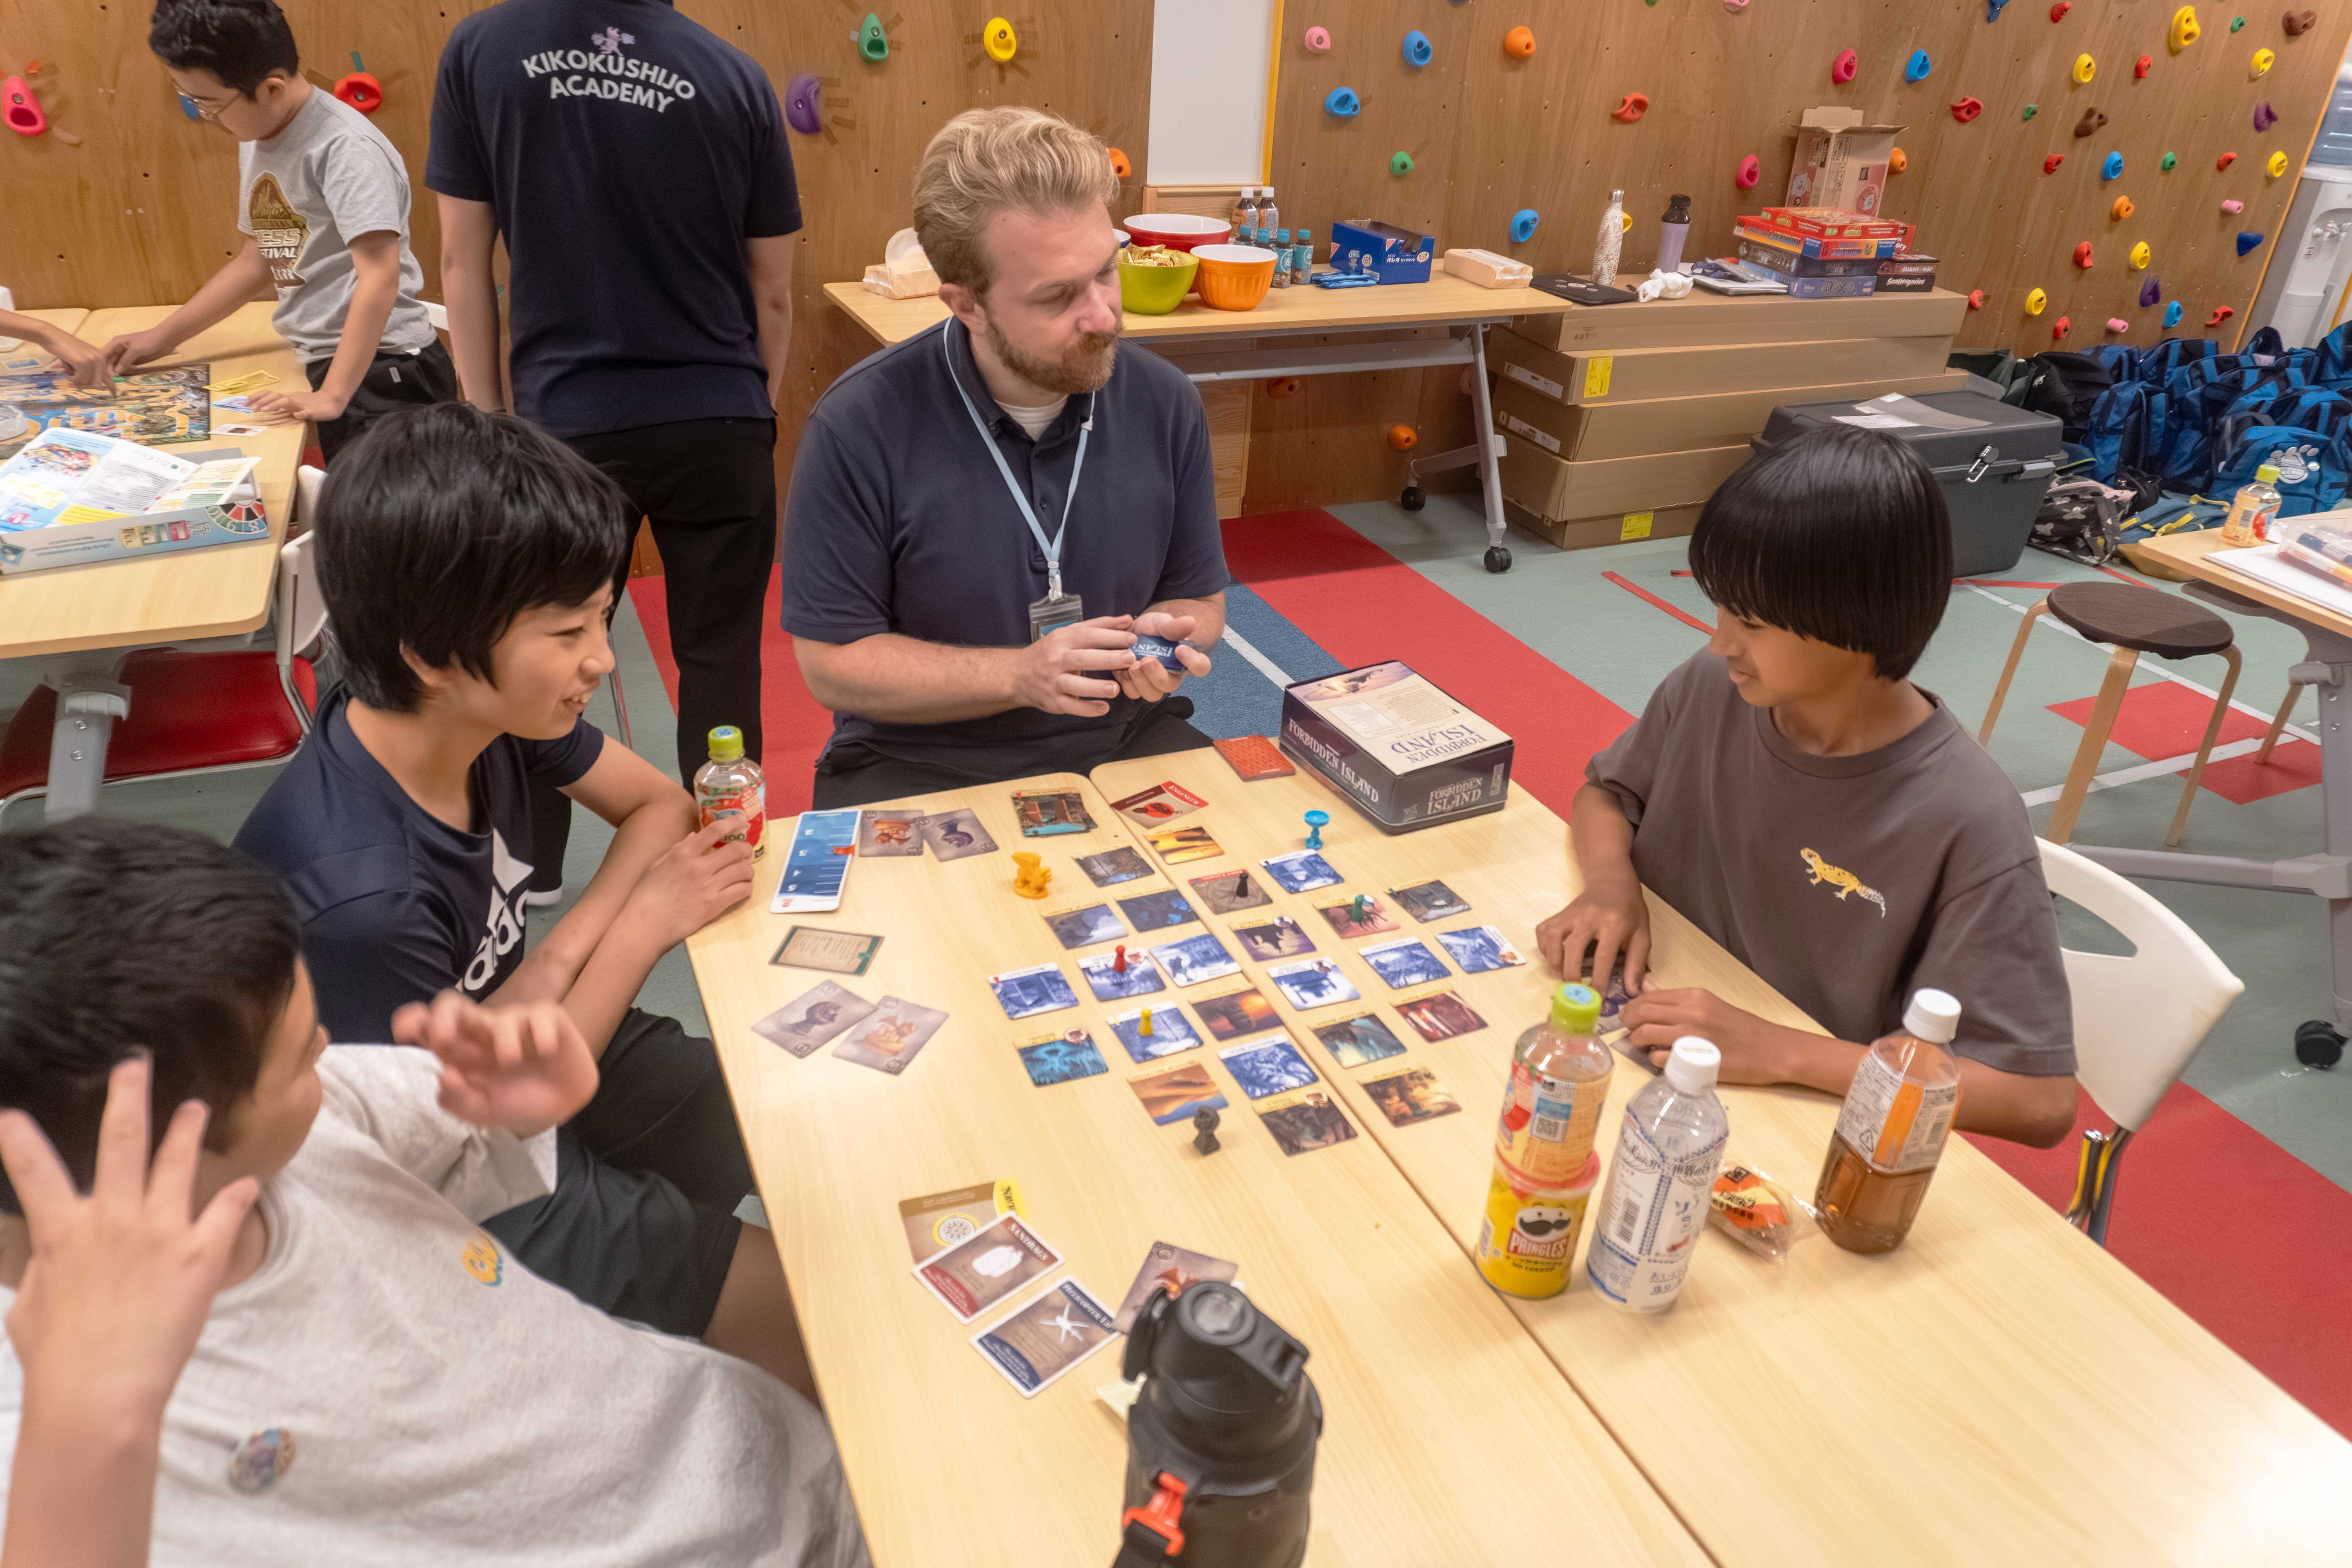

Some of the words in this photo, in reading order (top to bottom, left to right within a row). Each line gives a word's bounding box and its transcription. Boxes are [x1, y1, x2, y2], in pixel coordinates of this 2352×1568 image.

[521, 50, 696, 100] KIKOKUSHIJO
[550, 75, 675, 113] ACADEMY
[259, 247, 297, 259] TIVAL
[1391, 724, 1476, 753] ISLAND
[1406, 733, 1487, 763] FORBIDDEN
[1289, 718, 1339, 769] FORBIDDEN
[1341, 761, 1379, 803] ISLAND
[1428, 788, 1482, 815] ISLAND
[1430, 778, 1483, 801] FORBIDDEN
[1510, 1229, 1569, 1259] PRINGLES
